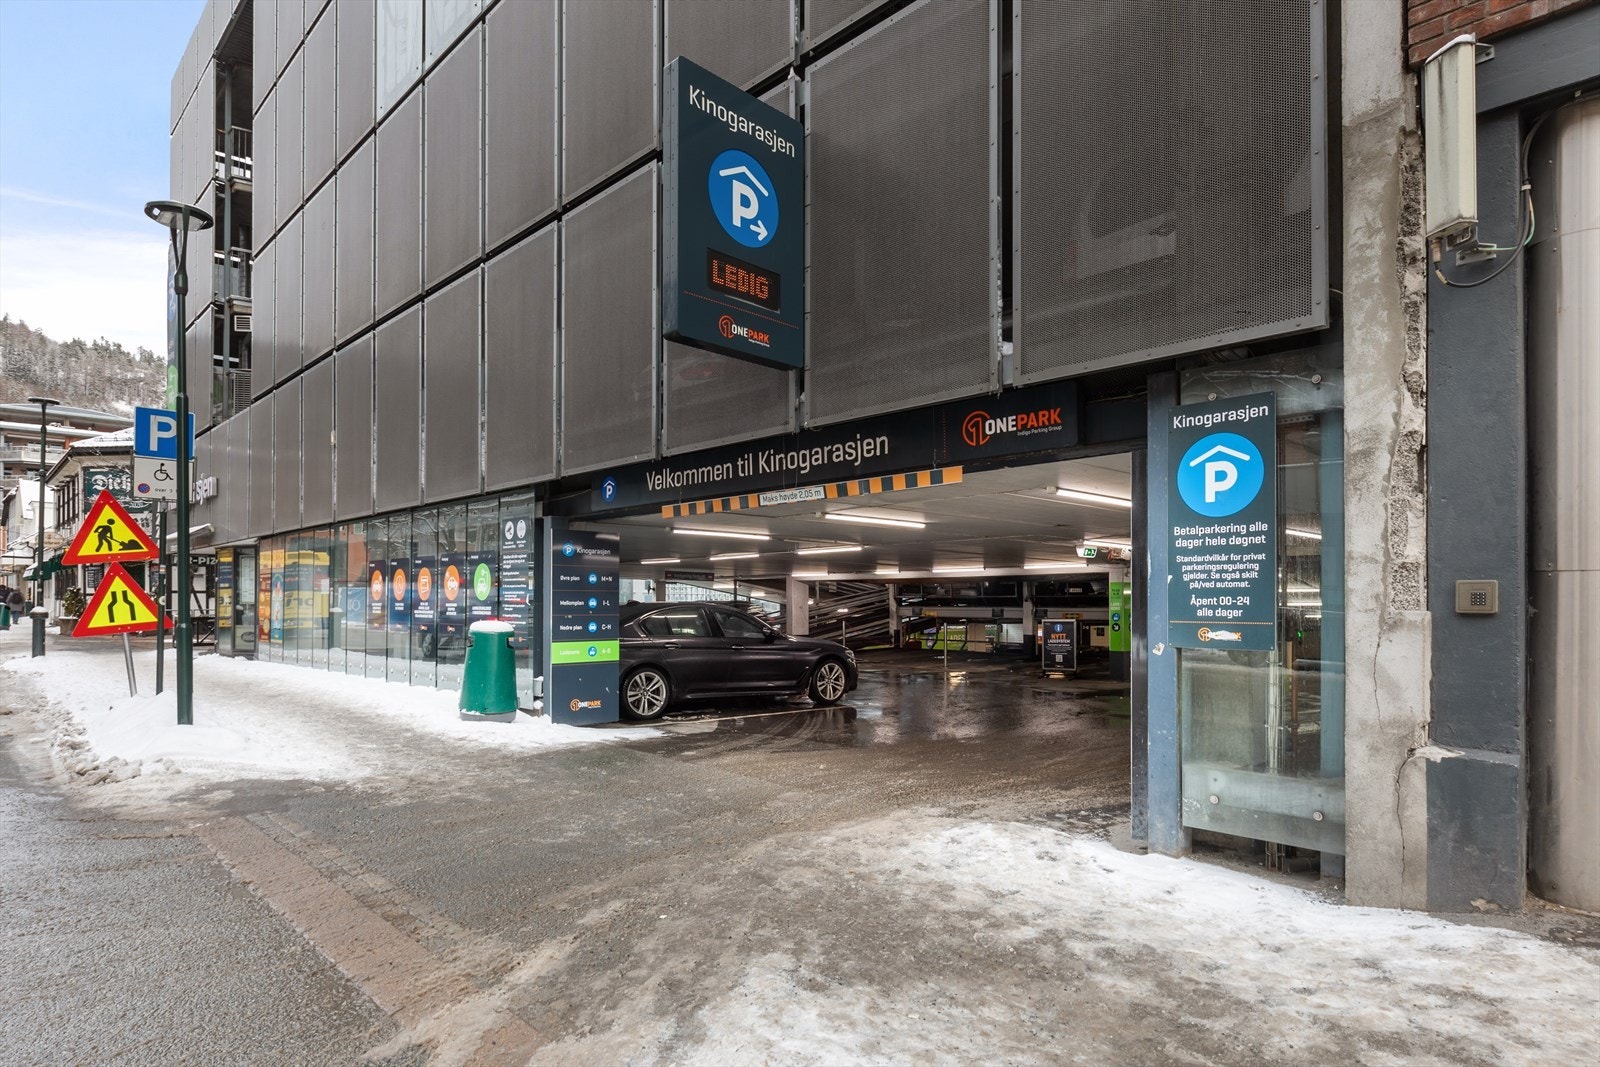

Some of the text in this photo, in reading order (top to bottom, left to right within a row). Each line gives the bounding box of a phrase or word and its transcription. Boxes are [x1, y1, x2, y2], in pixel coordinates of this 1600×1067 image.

[688, 84, 796, 158] Kinogarasjen
[712, 259, 769, 299] LEDIG
[731, 323, 770, 344] ONEPARK
[985, 407, 1062, 436] ONEPARK
[1173, 405, 1269, 429] Kinogarasjen
[150, 415, 176, 451] P
[646, 433, 889, 491] Velkommen til Kinogarasjen
[762, 495, 779, 503] Maks
[779, 491, 798, 500] høyde
[798, 489, 813, 499] 2,05
[1173, 521, 1268, 537] Betalparkering alle
[1175, 534, 1266, 549] dager hele døgnet
[1176, 552, 1266, 563] Standardvilkår for privat
[1182, 561, 1259, 573] parkeringsregulering
[1182, 570, 1258, 581] gjelder. Se også skilt
[1189, 580, 1251, 590] på/ved automat.
[1190, 594, 1250, 607] Åpent 00-24
[1196, 607, 1243, 619] alle dager
